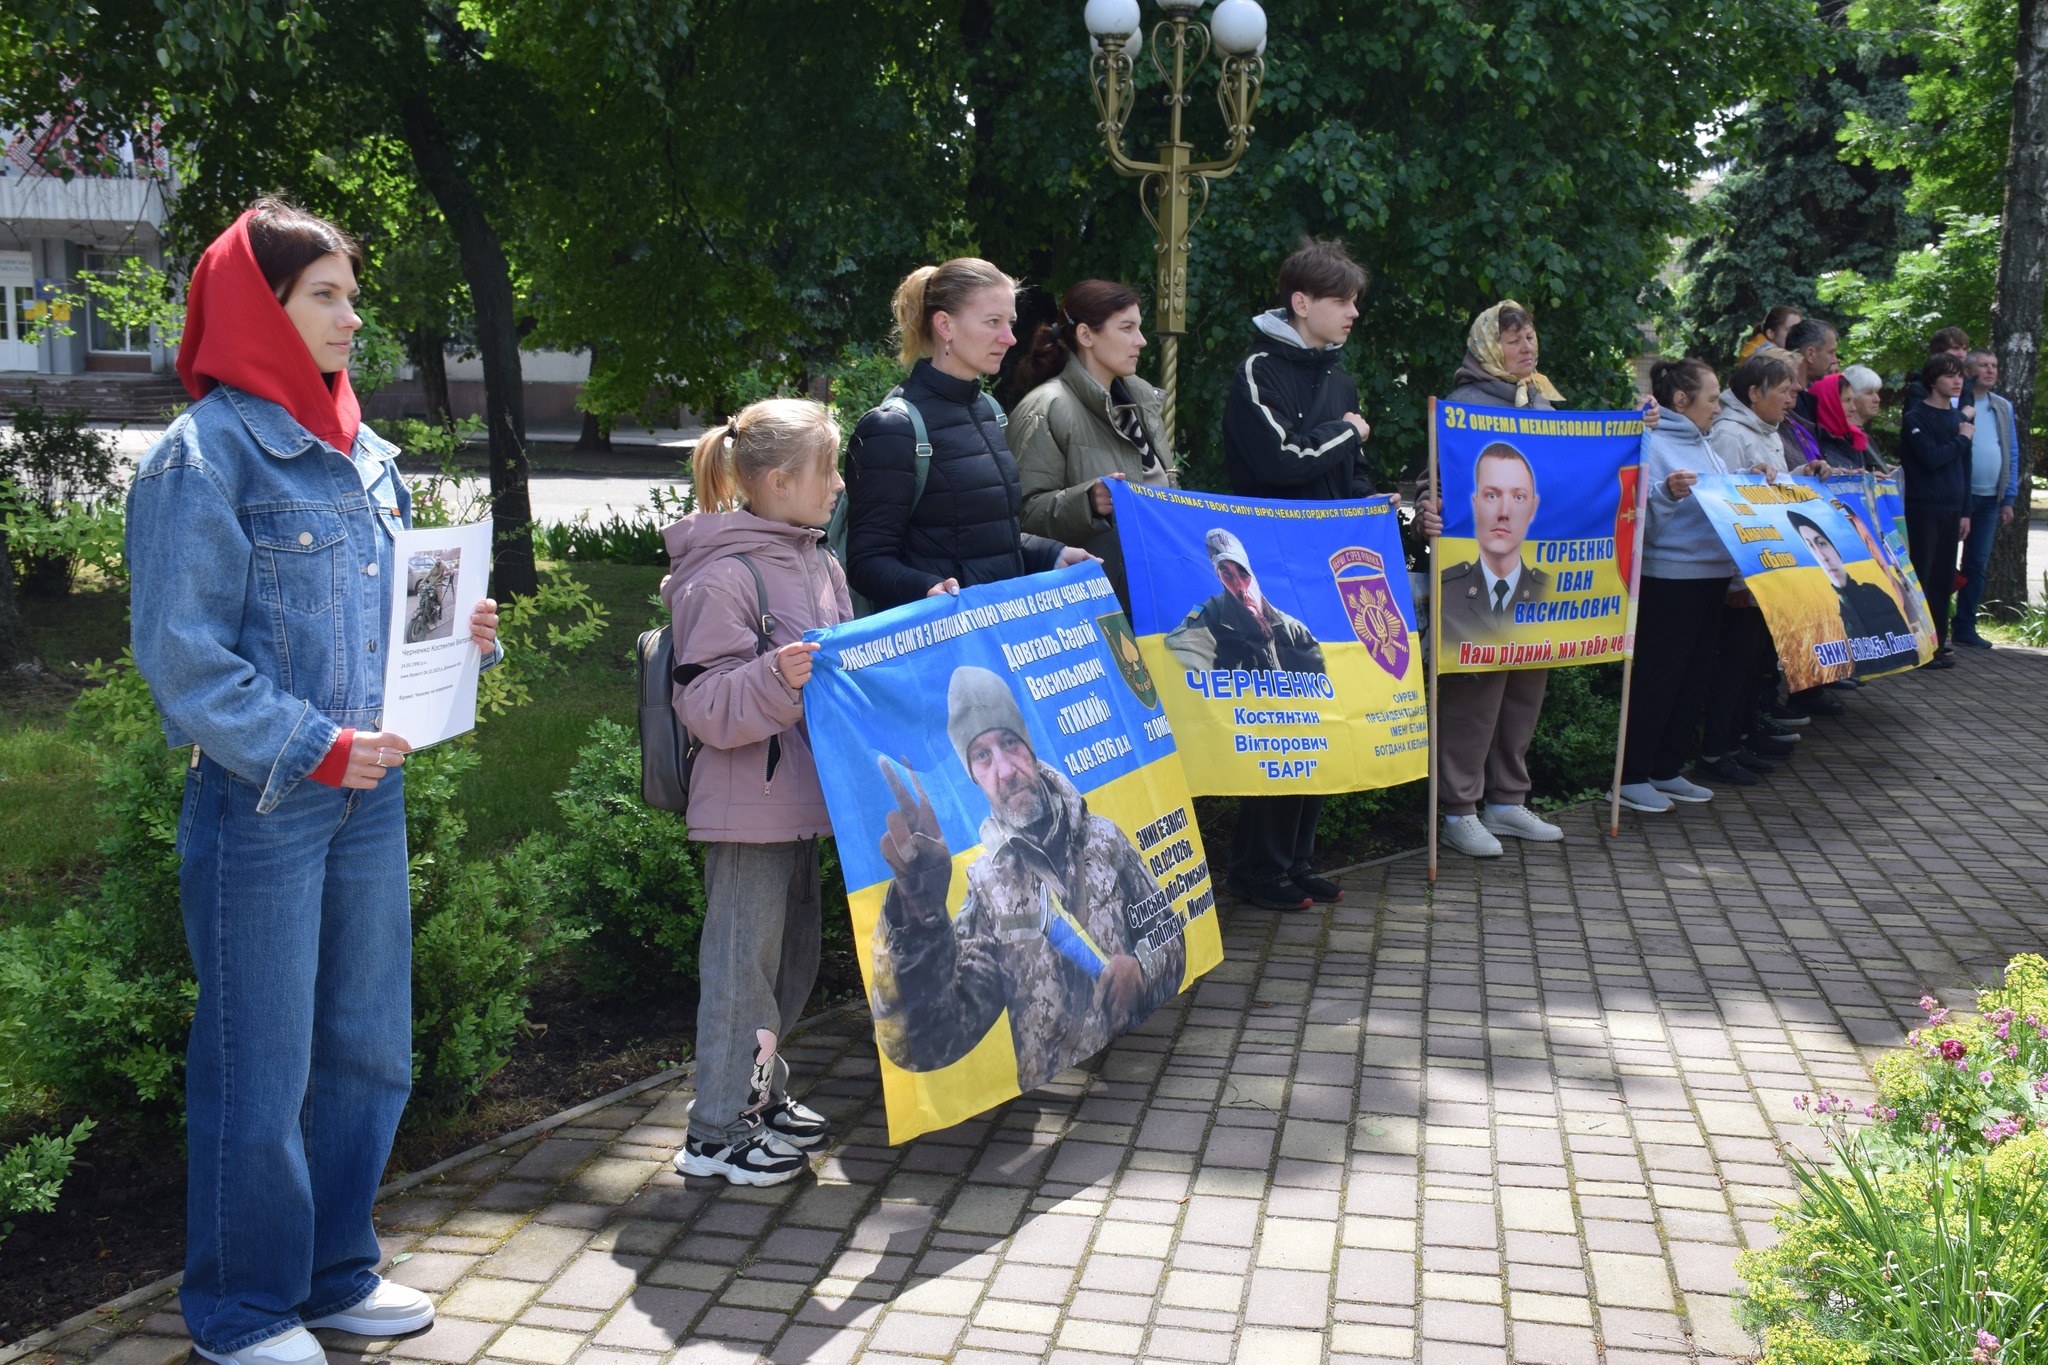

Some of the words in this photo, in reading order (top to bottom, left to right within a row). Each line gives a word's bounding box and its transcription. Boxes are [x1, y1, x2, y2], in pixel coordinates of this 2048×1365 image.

[1444, 406, 1467, 429] 32
[1469, 413, 1518, 433] ОКРЕМА
[1519, 418, 1603, 437] МЕХАНІЗОВАНА
[1155, 490, 1169, 502] НЕ
[1168, 493, 1204, 509] ЗЛАМАЄ
[1204, 500, 1230, 513] ТВОЮ
[1536, 537, 1615, 564] ГОРБЕНКО
[1556, 570, 1594, 593] ІВАН
[1514, 595, 1622, 625] ВАСИЛЬОВИЧ
[837, 635, 897, 672] ЛЮБЛЯЧА
[923, 623, 933, 647] З
[1026, 594, 1038, 616] В
[1034, 588, 1064, 614] СЕРЦІ
[1060, 580, 1091, 606] ЧЕКАЄ
[402, 646, 431, 657] Черненко
[1001, 634, 1062, 674] Довгаль
[1056, 618, 1099, 652] Сергій
[1459, 642, 1496, 667] Наш
[1499, 639, 1555, 667] рідний,
[1557, 640, 1578, 660] ми
[1580, 634, 1608, 658] тебе
[1813, 640, 1850, 668] ЗНИК
[1025, 657, 1106, 702] Васильович
[1185, 669, 1335, 699] ЧЕРНЕНКО
[1056, 690, 1112, 736] «ТИХИЙ»
[1233, 706, 1321, 726] Костянтин
[1064, 736, 1118, 777] 14.09.1976
[1114, 734, 1133, 758] р.н.
[1234, 733, 1329, 755] Вікторович
[1258, 760, 1318, 779] "БАРІ"
[1135, 827, 1161, 853] ЗНИК
[1127, 889, 1170, 929] Сумська
